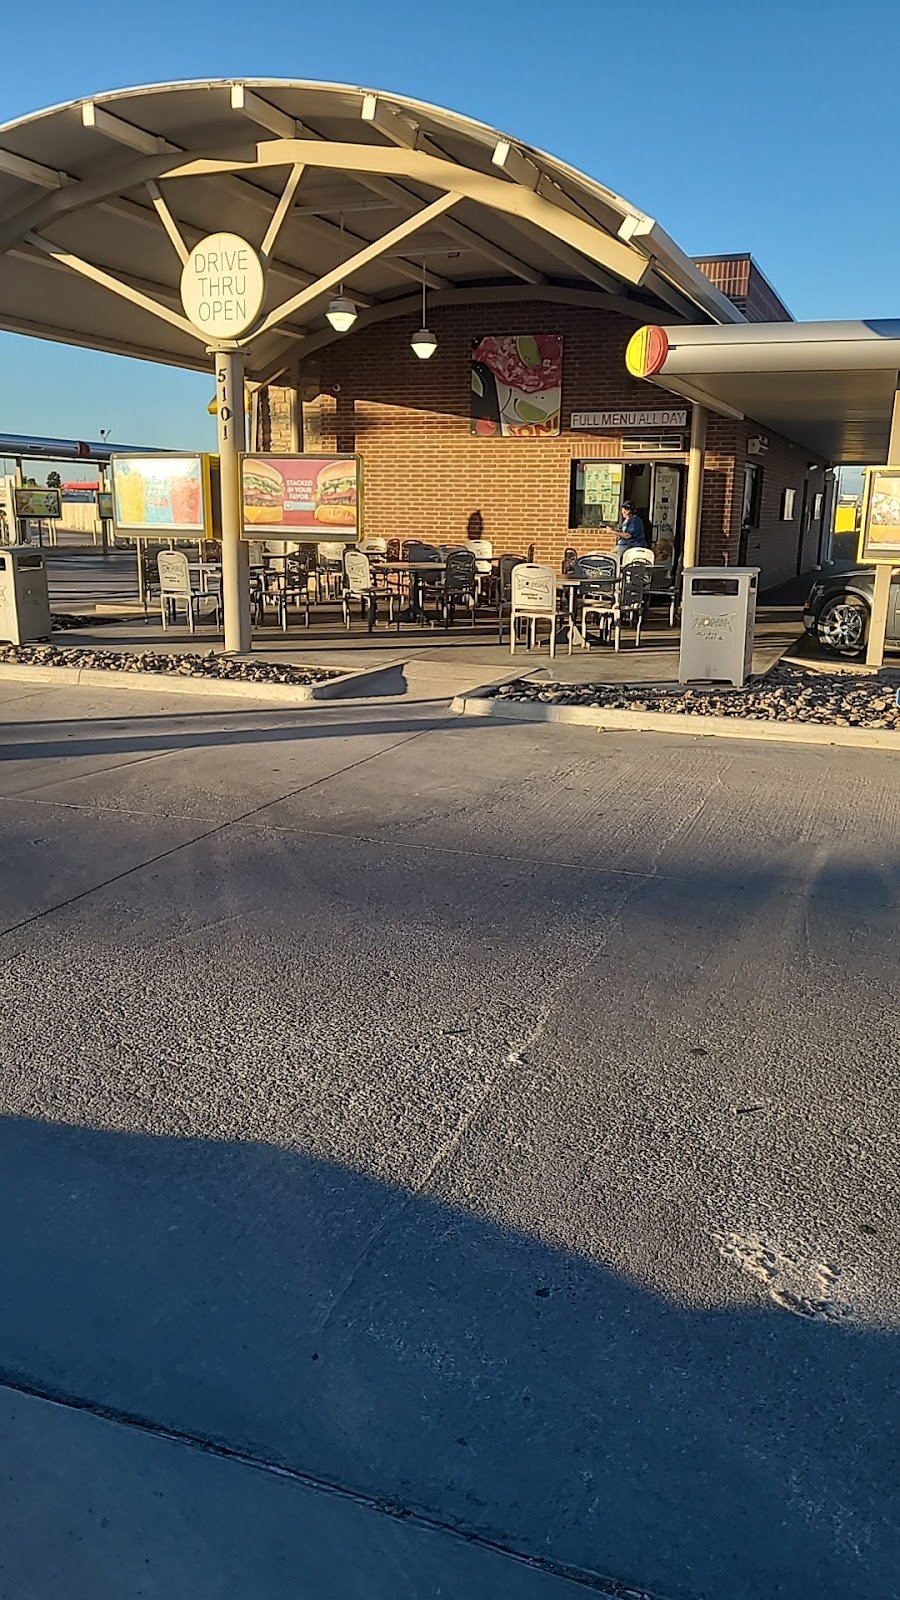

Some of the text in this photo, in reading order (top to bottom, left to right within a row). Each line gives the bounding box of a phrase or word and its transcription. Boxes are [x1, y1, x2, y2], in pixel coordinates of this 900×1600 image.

[194, 250, 248, 274] DRIVE
[198, 275, 246, 297] THRU
[198, 299, 246, 322] OPEN
[217, 368, 232, 440] 5101
[572, 412, 685, 426] FULL MENU ALL DAY
